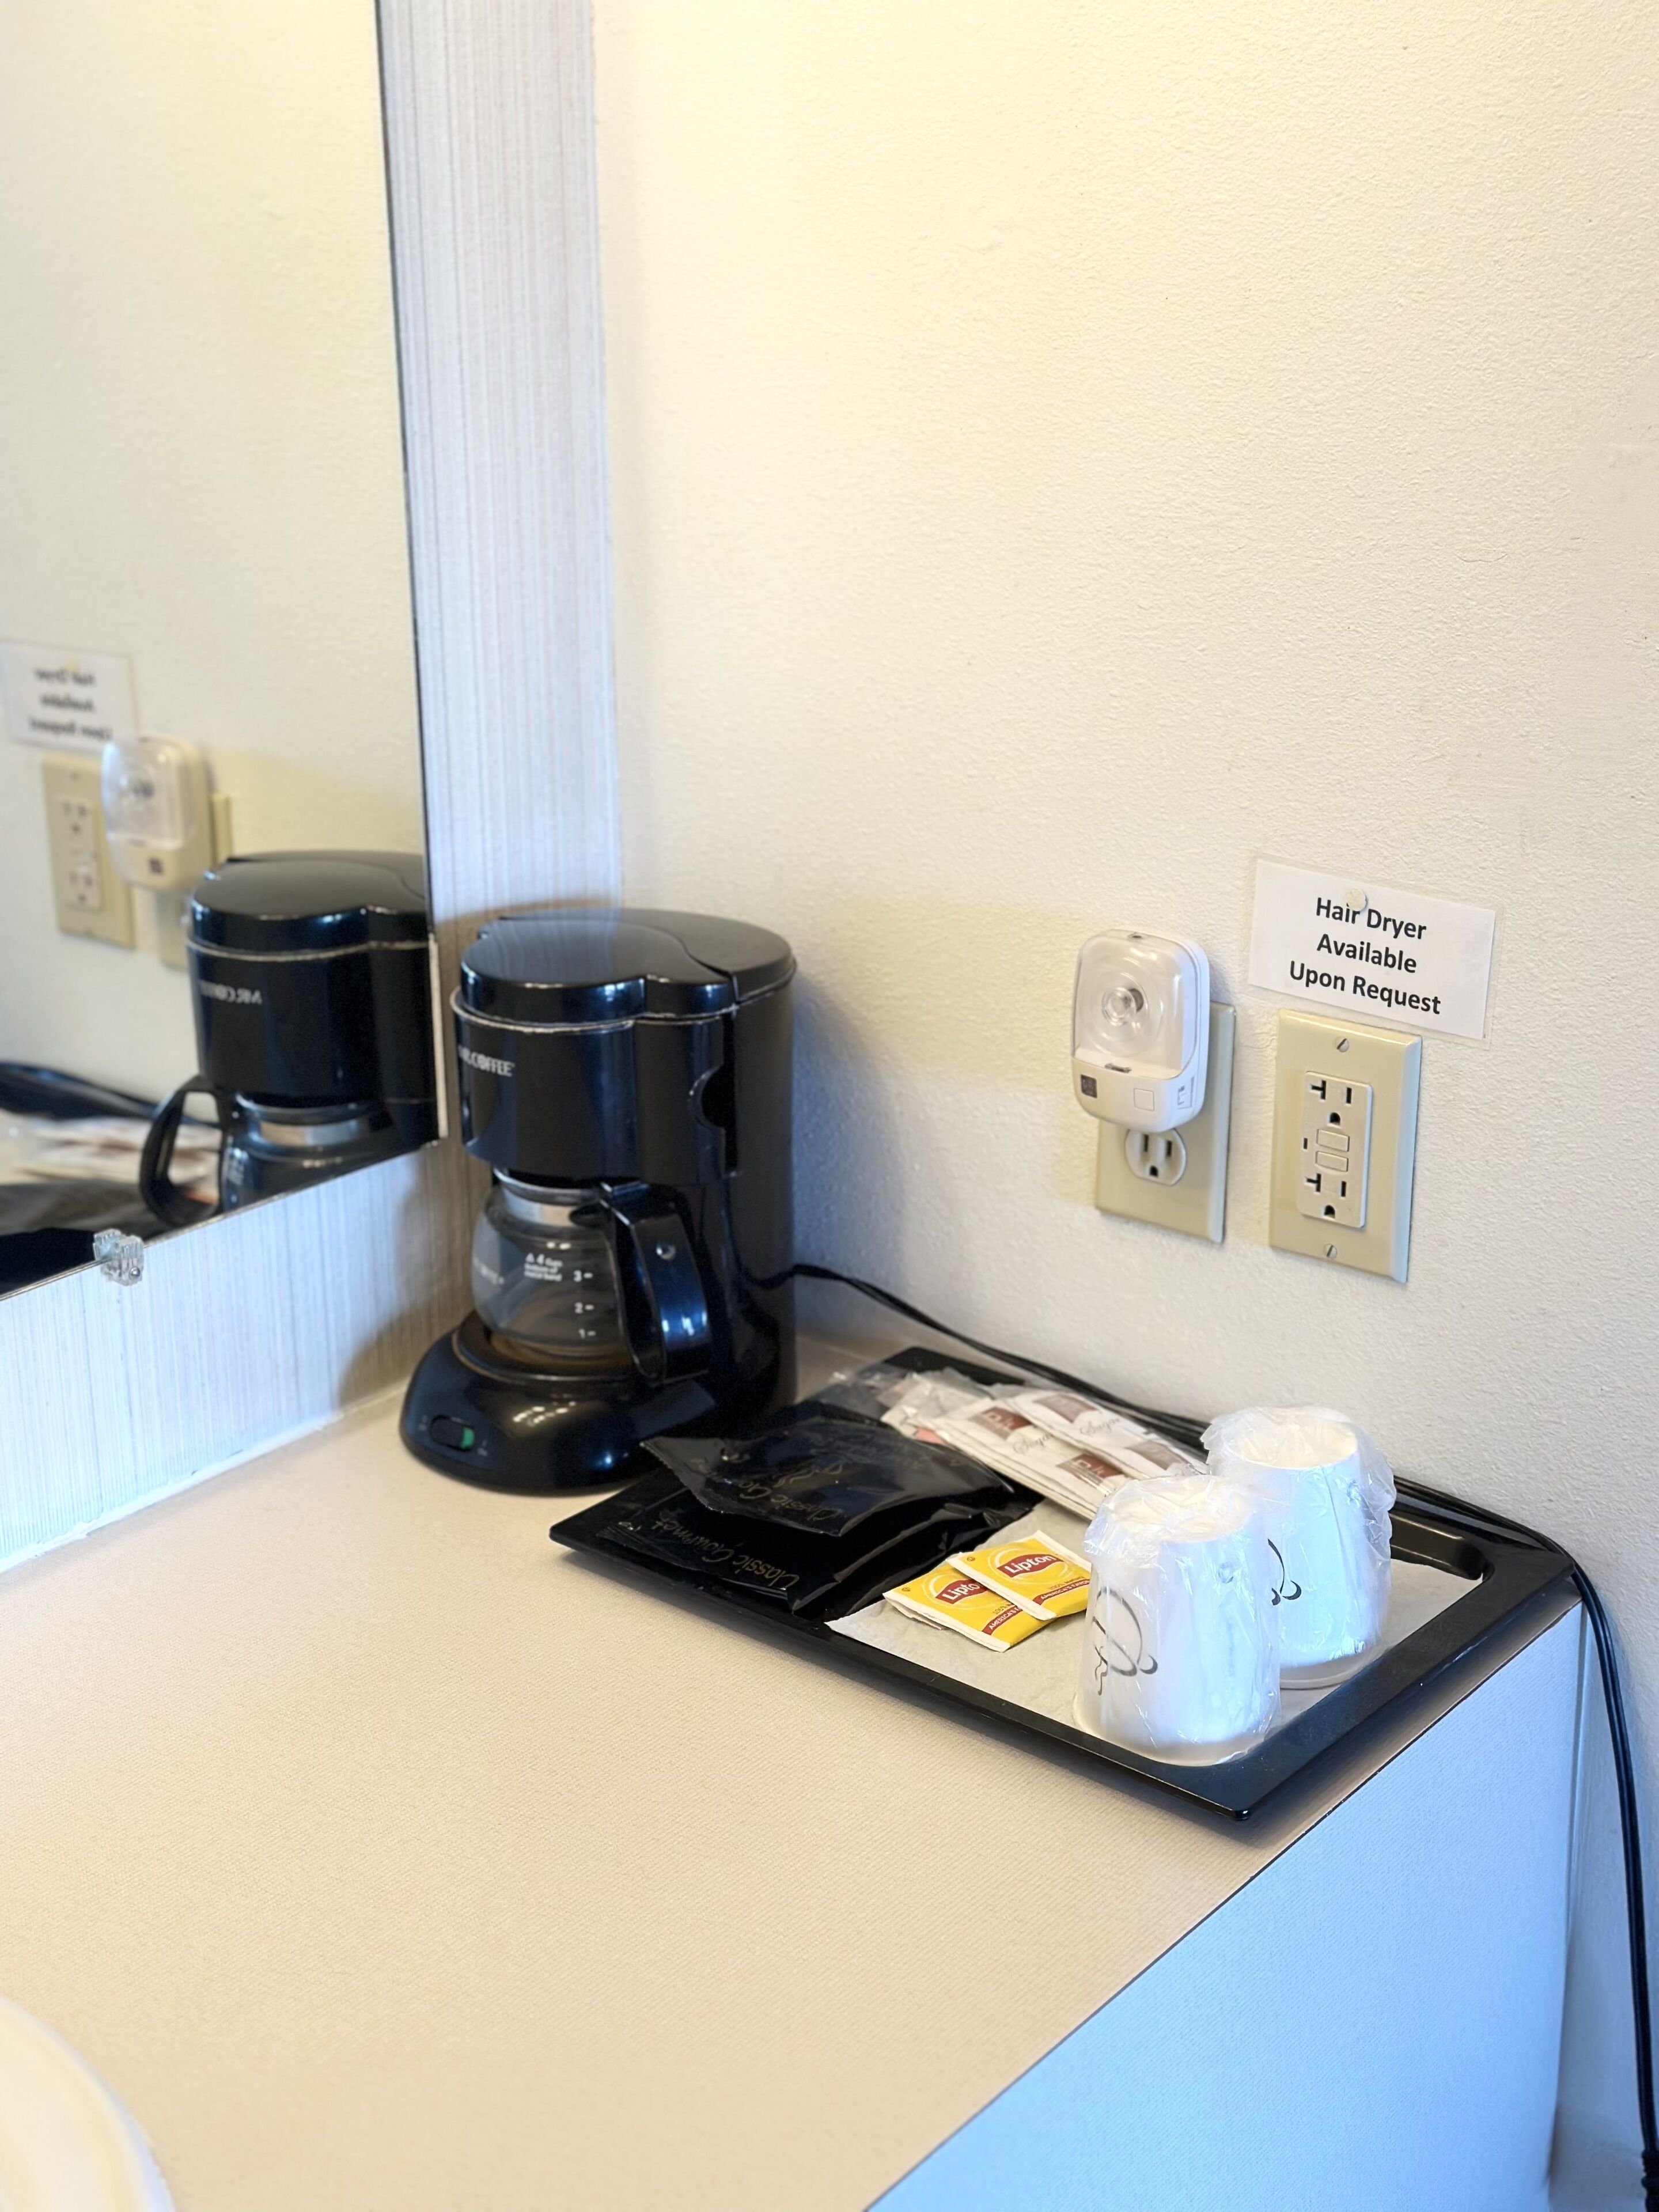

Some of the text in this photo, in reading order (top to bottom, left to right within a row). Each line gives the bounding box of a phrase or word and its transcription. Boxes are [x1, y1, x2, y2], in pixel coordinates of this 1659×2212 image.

[1316, 897, 1427, 940] Hair Dryer
[1316, 933, 1417, 974] Available
[1289, 960, 1441, 1015] Upon Request
[651, 1518, 800, 1589] Classic Gourmet
[1005, 1555, 1057, 1574] Lipton
[942, 1583, 980, 1600] Lipto
